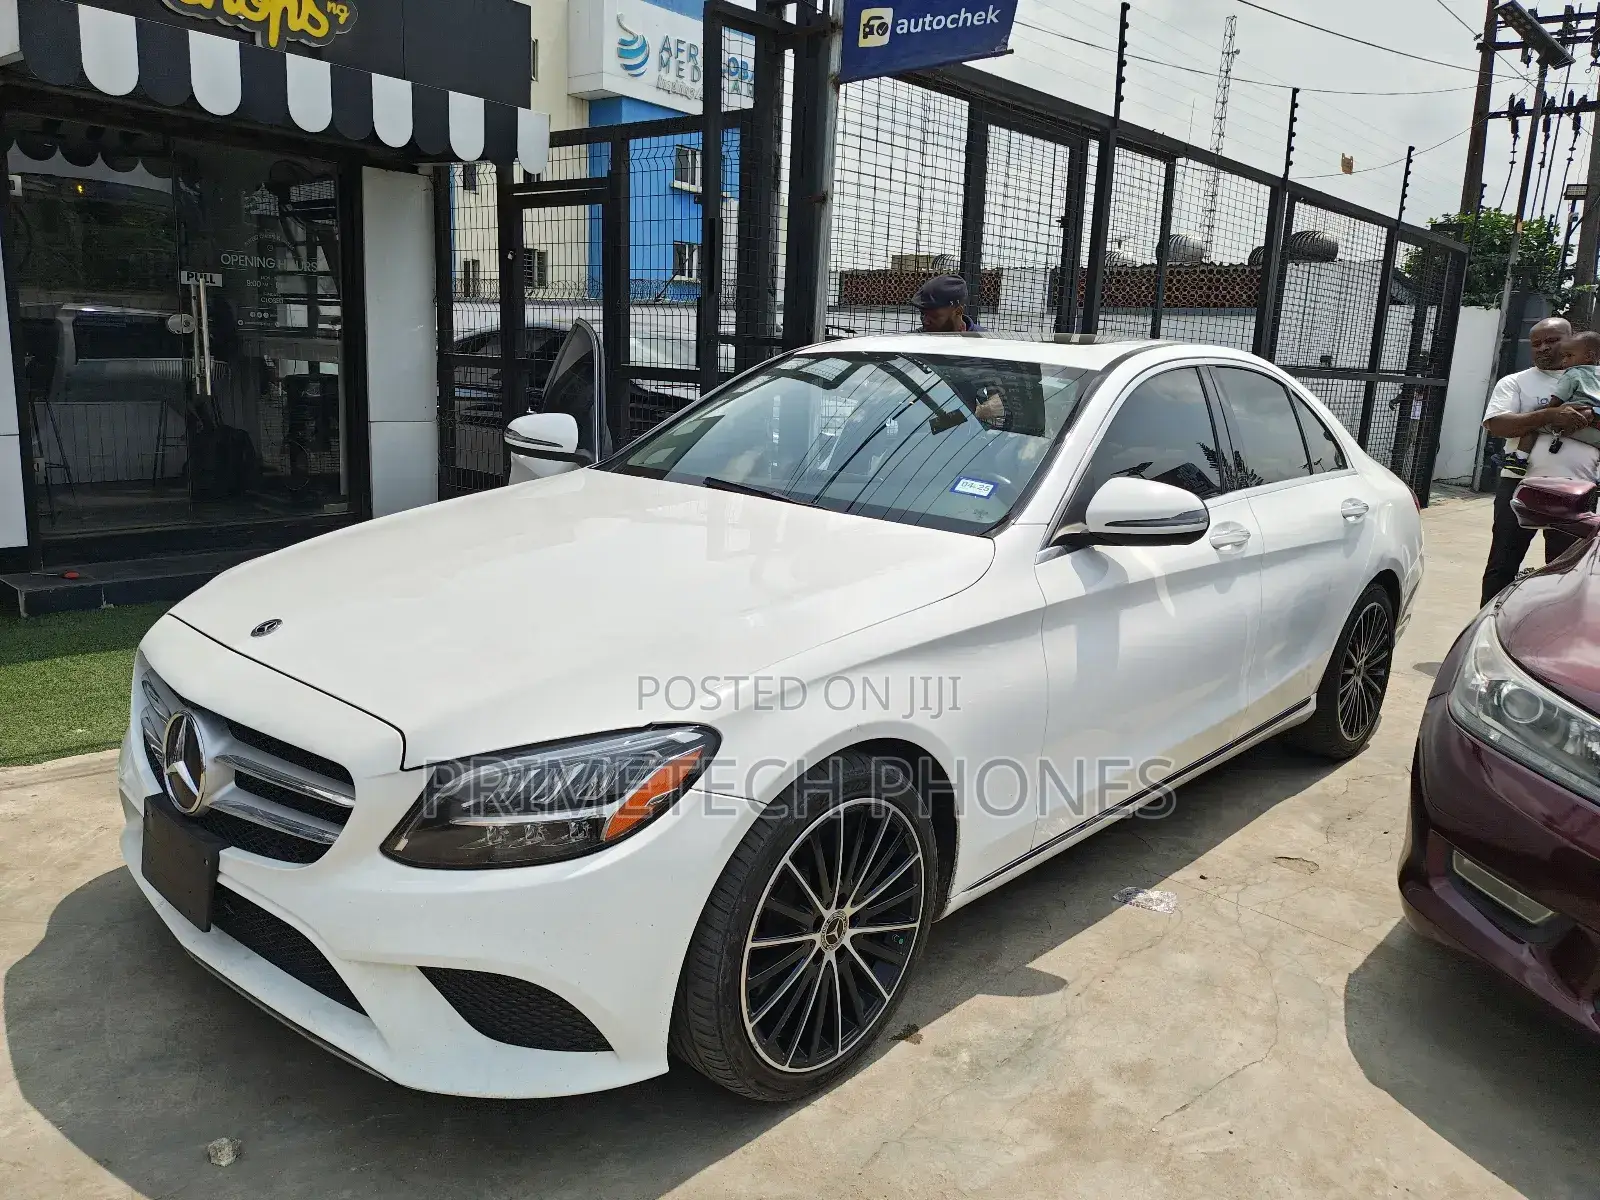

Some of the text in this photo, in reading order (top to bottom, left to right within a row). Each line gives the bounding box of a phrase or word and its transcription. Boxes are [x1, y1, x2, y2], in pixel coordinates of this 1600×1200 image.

[895, 4, 1001, 35] autochek
[220, 253, 318, 273] OPENING HURS
[186, 271, 216, 285] PULL
